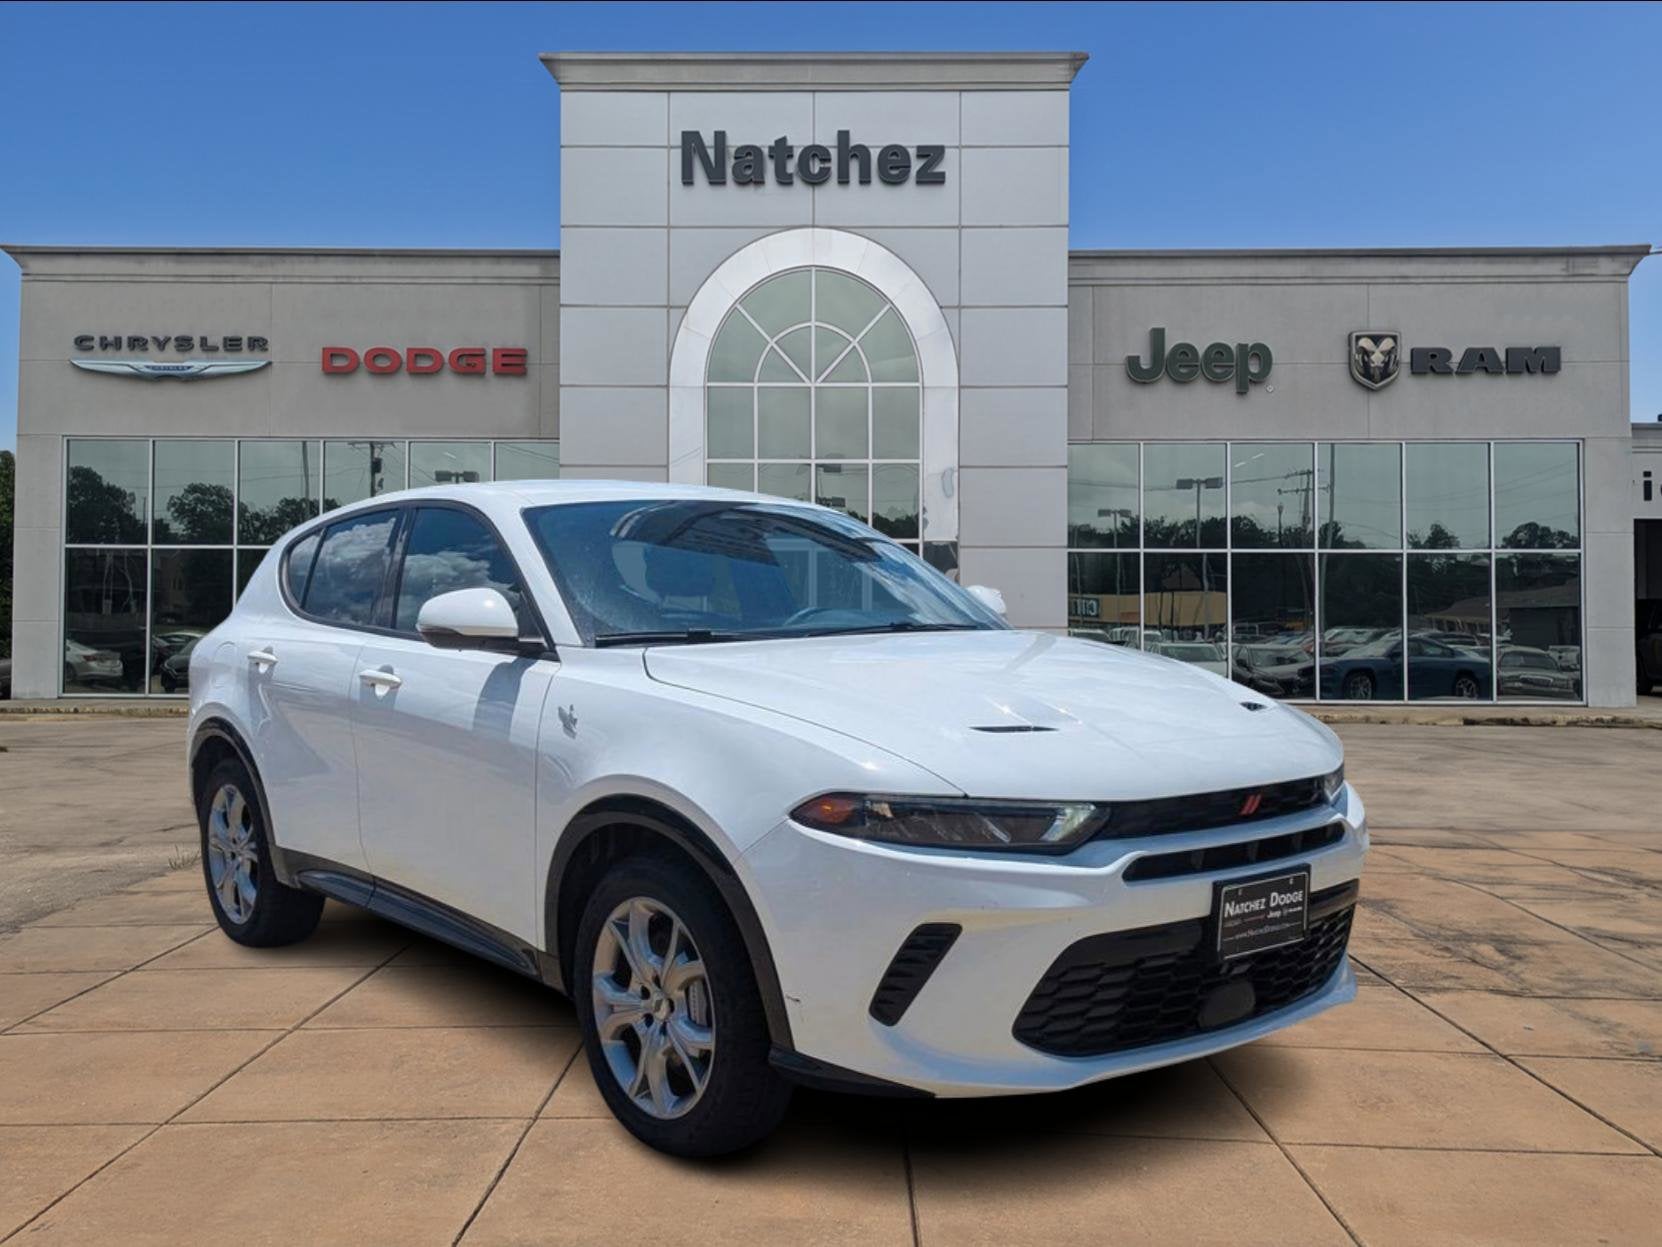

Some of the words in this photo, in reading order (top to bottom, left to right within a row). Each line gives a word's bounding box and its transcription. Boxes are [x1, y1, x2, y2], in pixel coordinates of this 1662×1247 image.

[681, 130, 946, 186] Natchez
[74, 334, 269, 352] CHRYSLER
[321, 347, 528, 376] DODGE
[1126, 327, 1273, 395] Jeep
[1410, 346, 1562, 375] RAM
